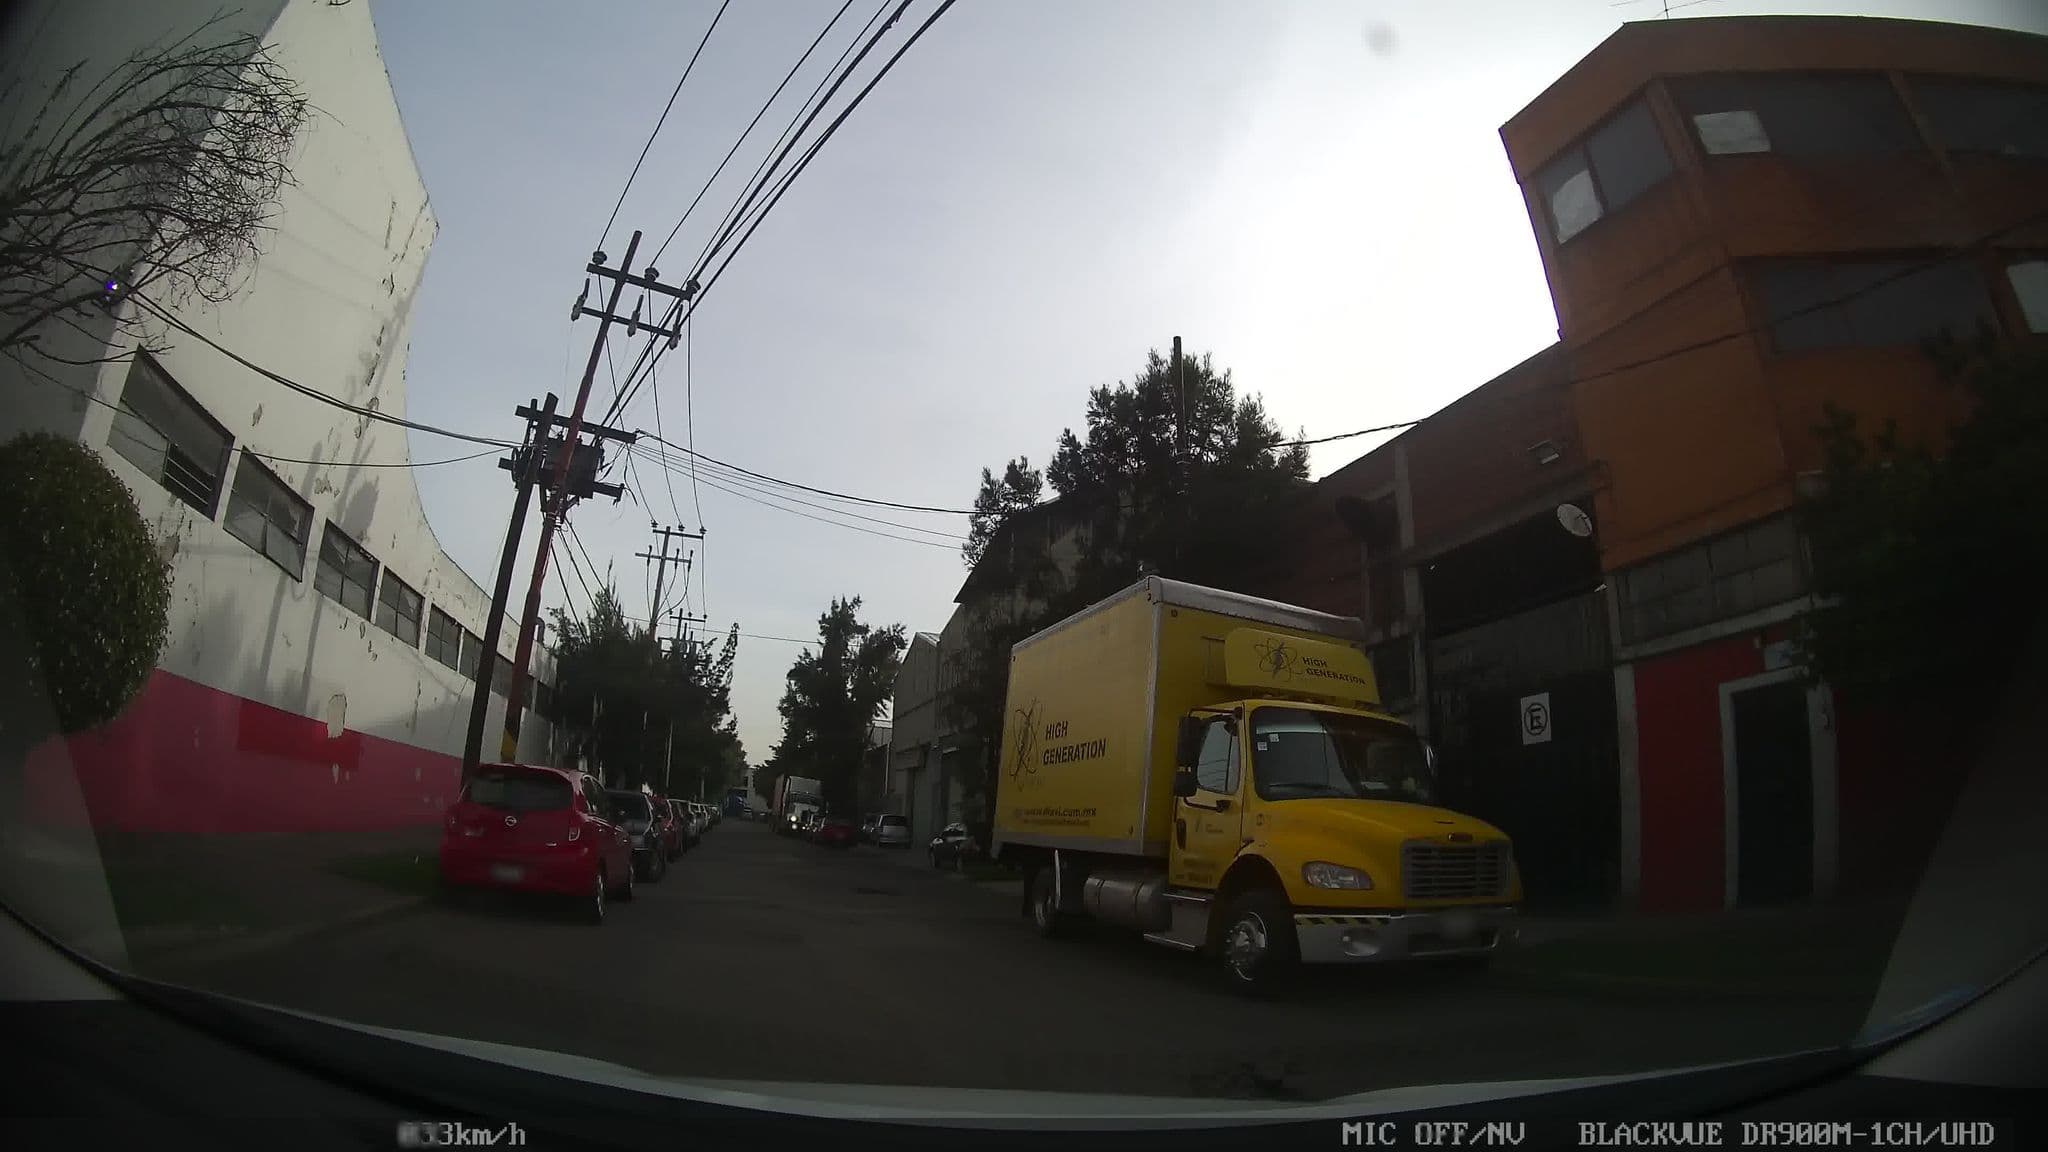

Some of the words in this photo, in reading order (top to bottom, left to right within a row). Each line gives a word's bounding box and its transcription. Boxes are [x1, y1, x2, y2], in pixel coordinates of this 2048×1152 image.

[1303, 656, 1327, 667] HIGH
[1306, 668, 1366, 685] GENERATION
[1045, 720, 1068, 740] HIGH
[1043, 738, 1107, 765] GENERATION
